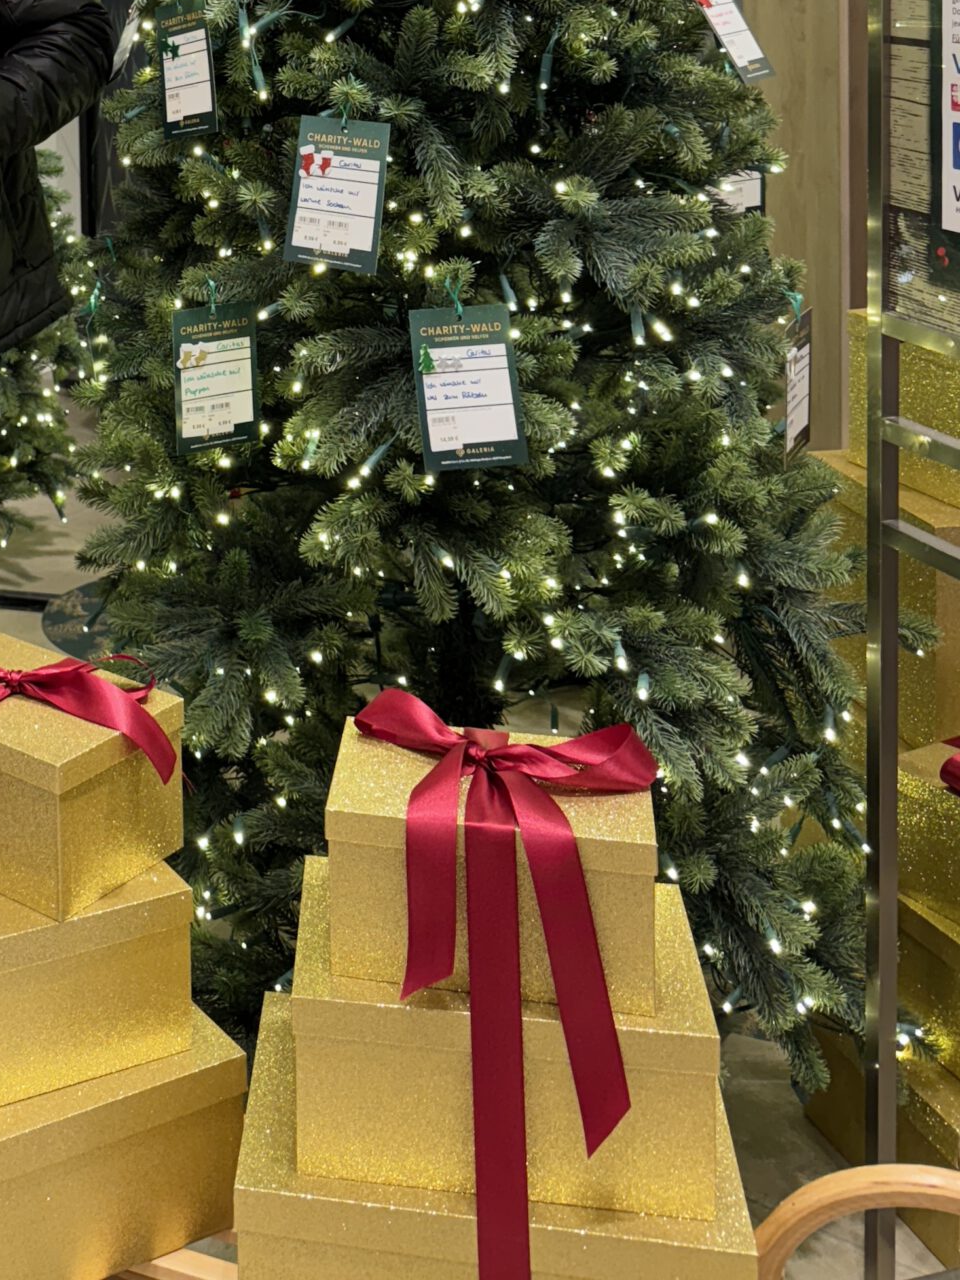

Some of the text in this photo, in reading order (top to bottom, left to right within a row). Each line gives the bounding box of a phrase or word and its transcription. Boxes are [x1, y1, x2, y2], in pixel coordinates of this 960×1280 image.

[161, 10, 204, 28] CHARITY-WALD
[307, 132, 381, 148] CHARITY-WALD
[180, 317, 249, 336] CHARITY-WALD
[419, 322, 502, 336] CHARITY-WALD
[466, 446, 495, 454] GALERIA
